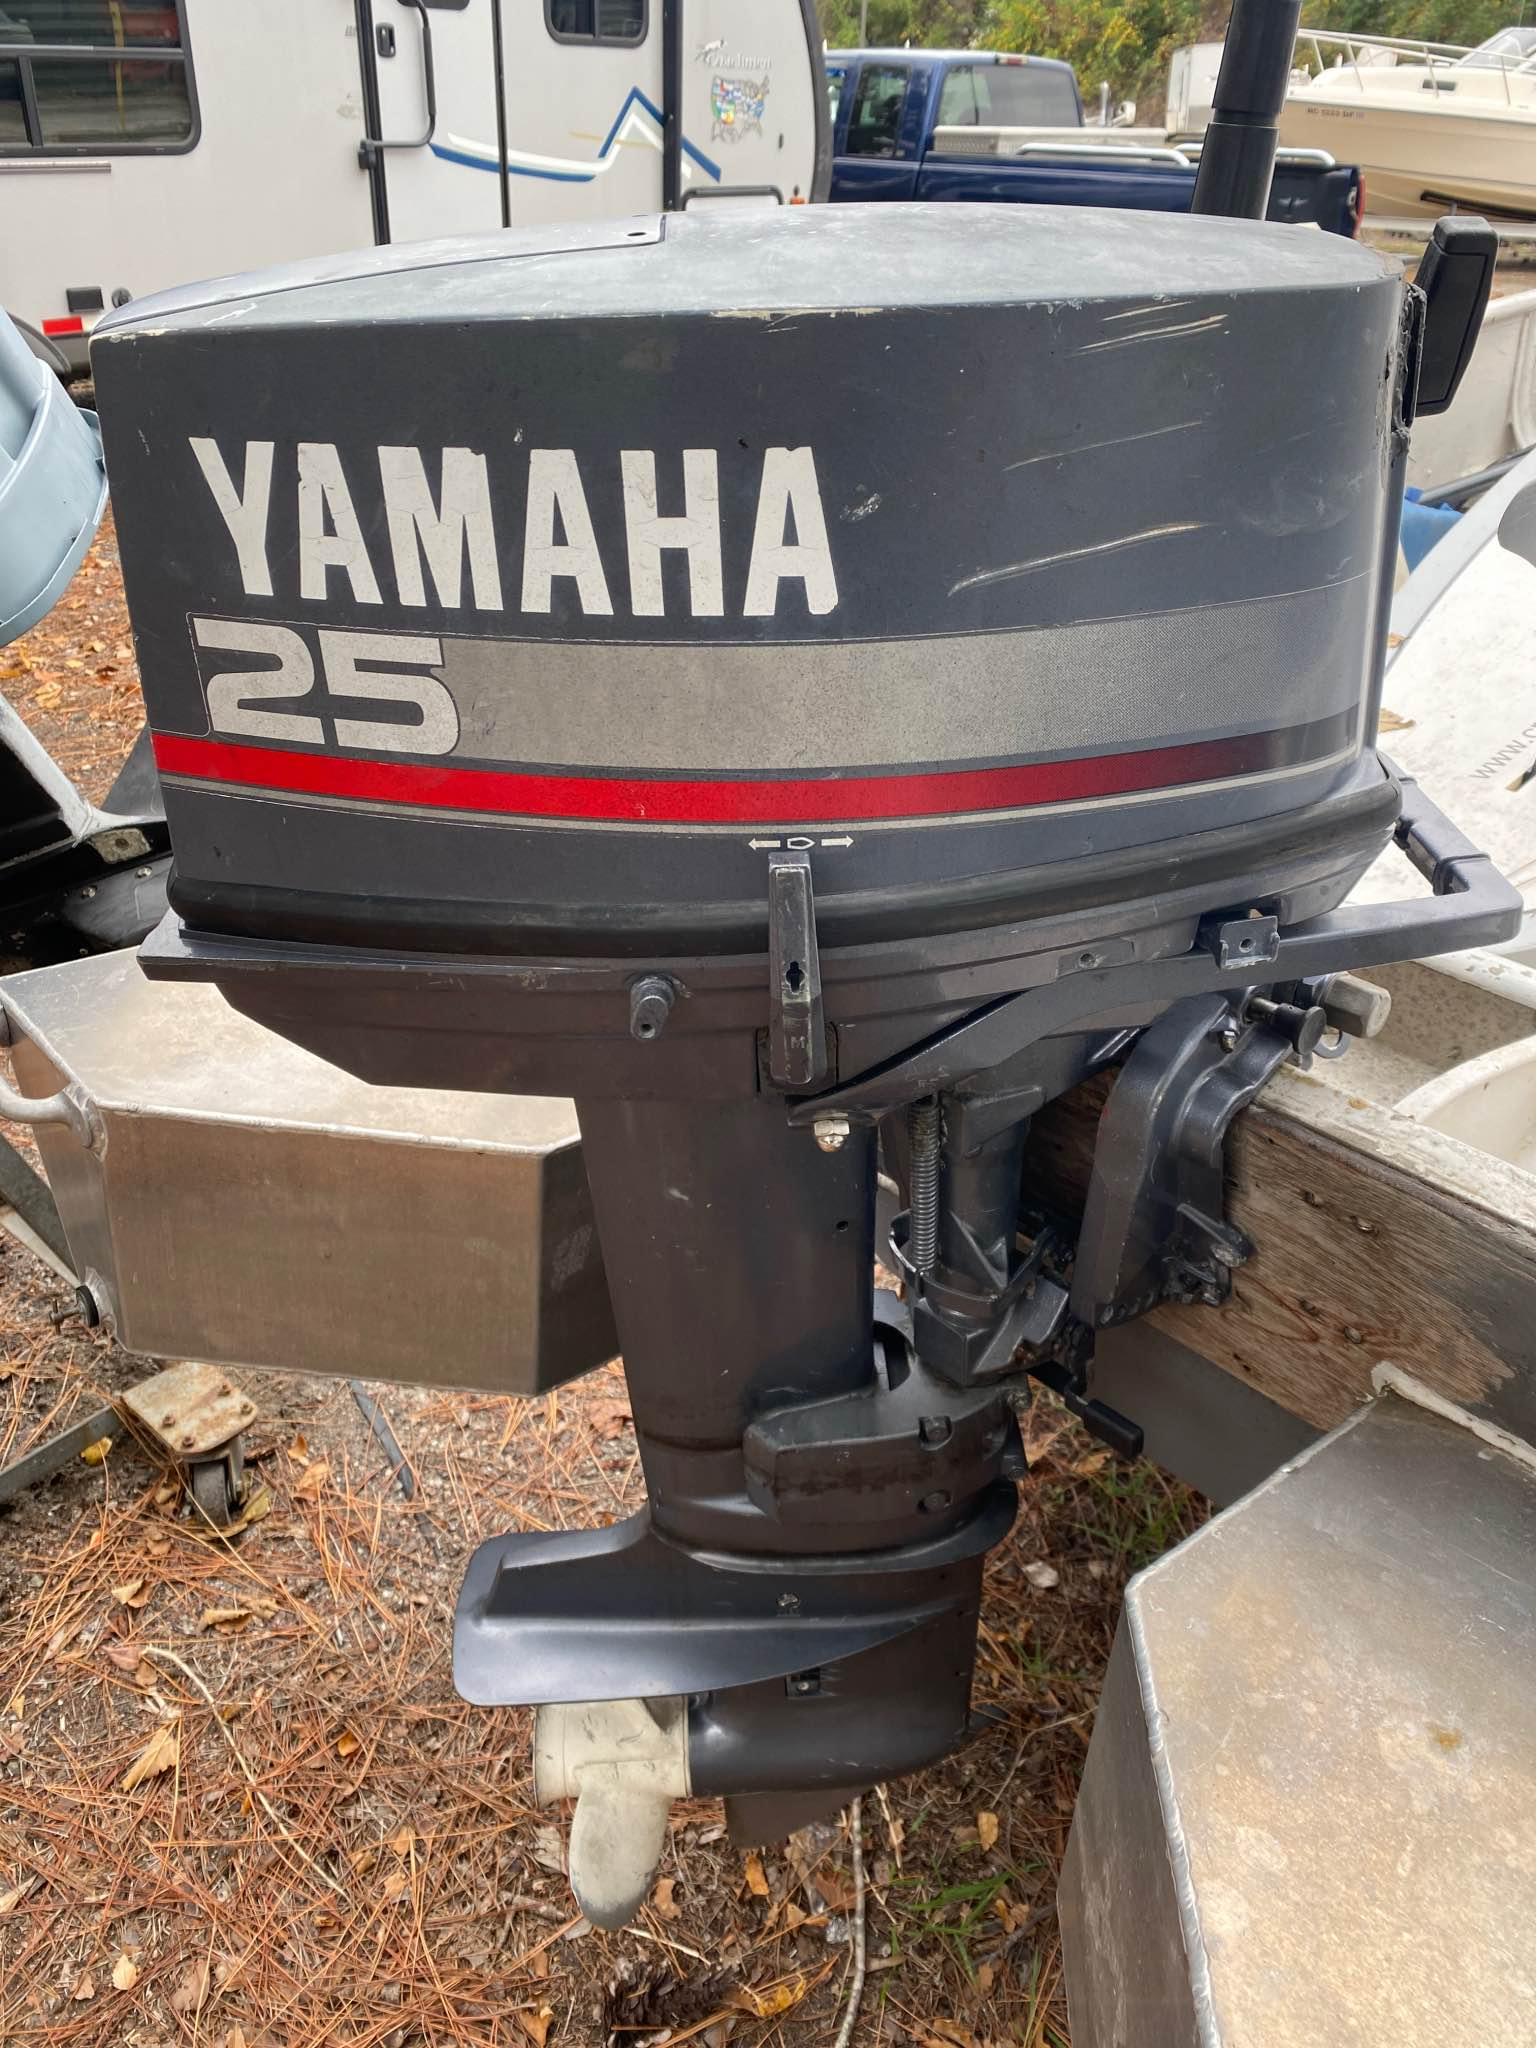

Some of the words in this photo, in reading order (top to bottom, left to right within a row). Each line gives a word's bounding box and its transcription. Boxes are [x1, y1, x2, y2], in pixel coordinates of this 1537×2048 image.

[188, 436, 839, 617] YAMAHA
[193, 617, 460, 756] 25
[1468, 722, 1537, 779] www.c
